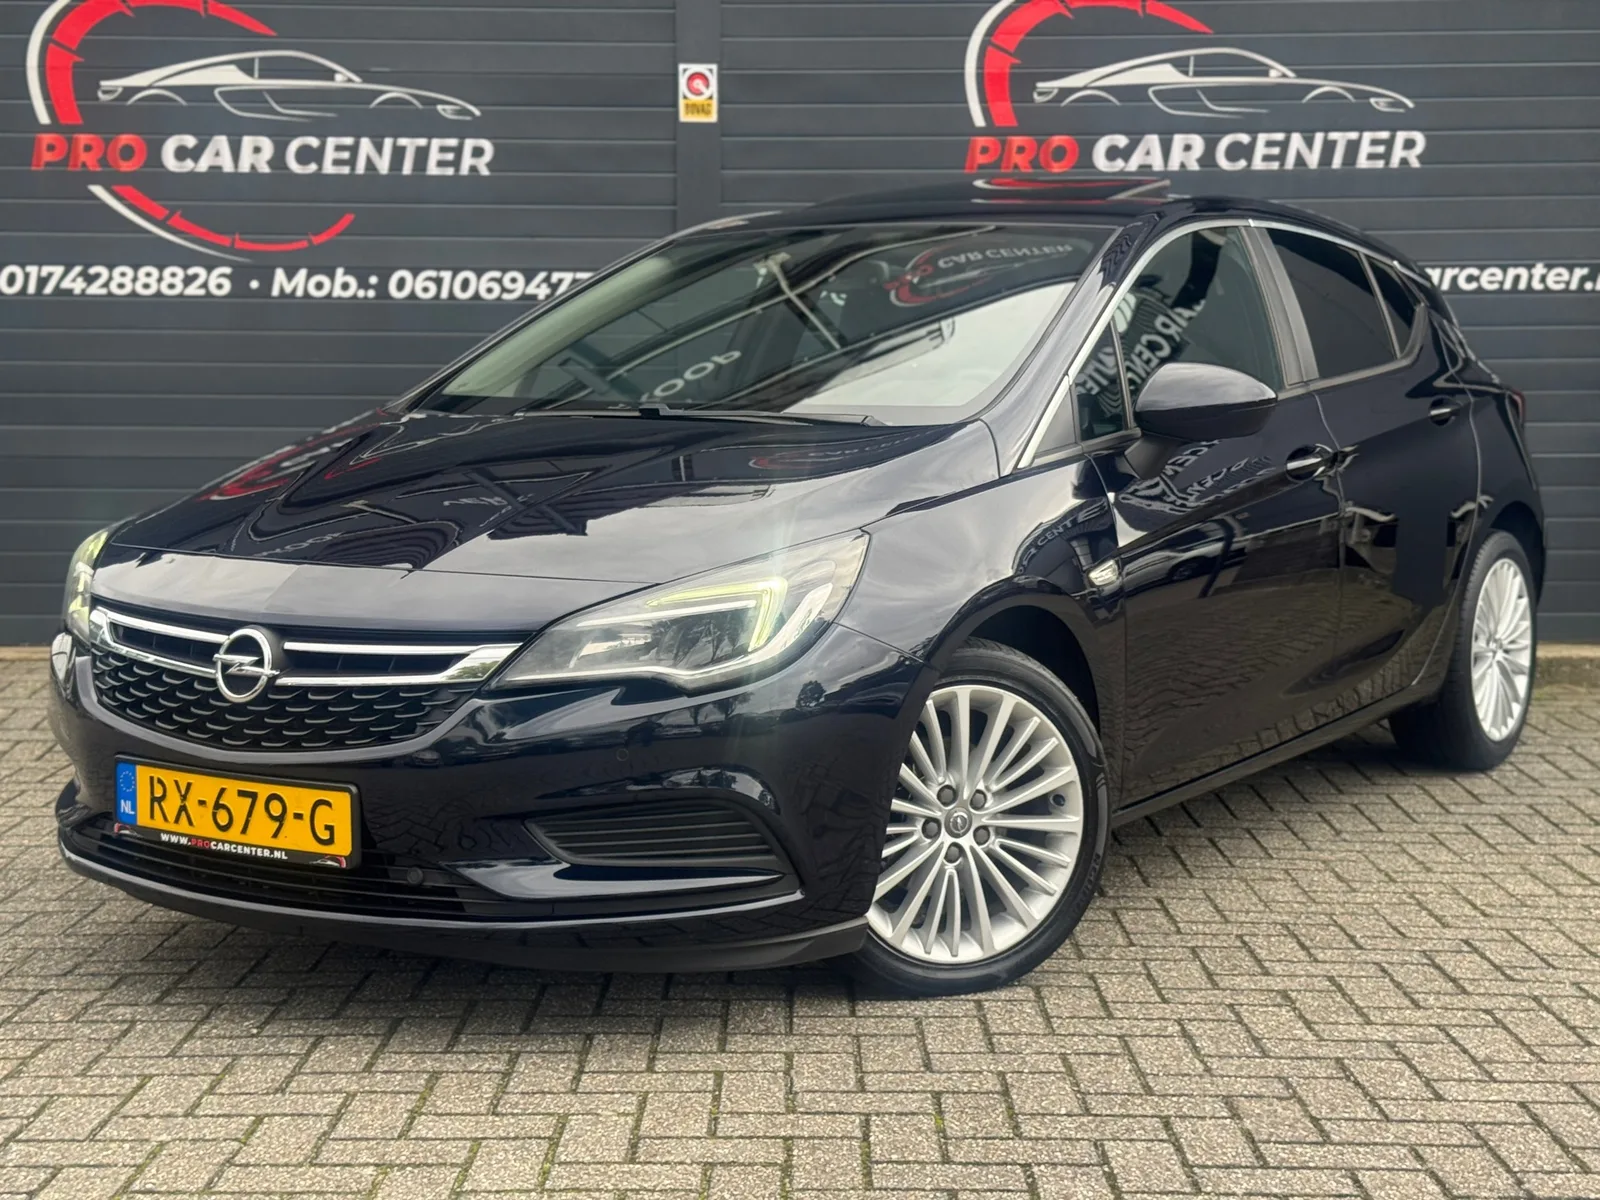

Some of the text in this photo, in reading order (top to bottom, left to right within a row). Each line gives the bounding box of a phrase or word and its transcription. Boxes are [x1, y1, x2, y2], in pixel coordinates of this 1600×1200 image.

[31, 134, 495, 176] PRO CAR CENTER
[964, 130, 1427, 174] PRO CAR CENTER
[0, 264, 233, 297] 0174288826
[271, 267, 377, 299] Mob.:
[1424, 262, 1600, 292] rcenter.
[120, 799, 136, 815] NL
[149, 775, 335, 847] RX-679-G
[160, 832, 289, 860] WWW.PROCARCENTER.NL
